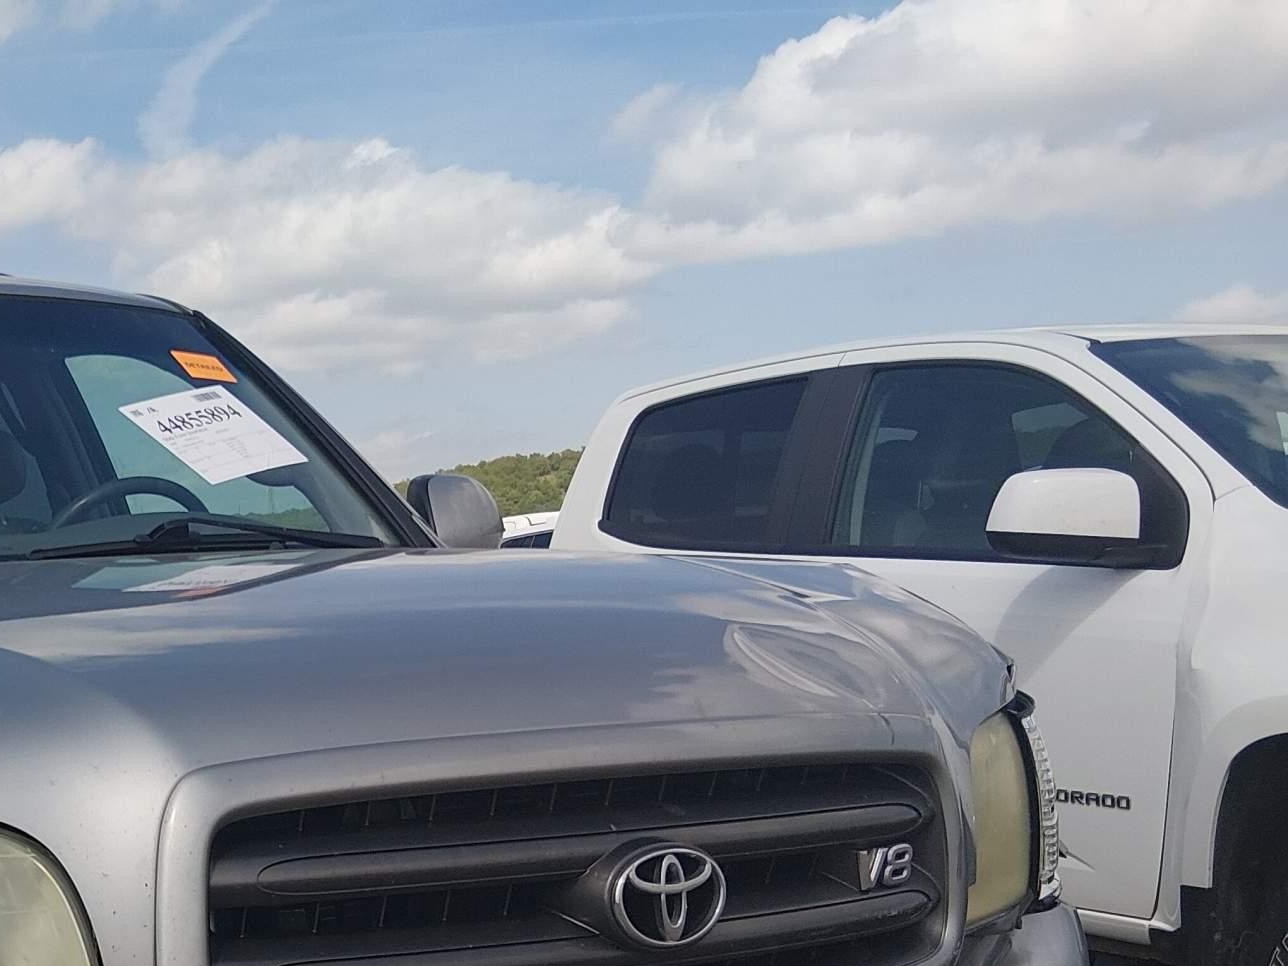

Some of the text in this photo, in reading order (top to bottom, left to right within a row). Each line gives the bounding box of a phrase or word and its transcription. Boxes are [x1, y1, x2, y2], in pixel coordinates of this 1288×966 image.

[157, 405, 242, 435] 44855894
[1055, 788, 1131, 811] ORADO
[856, 843, 913, 891] V8
